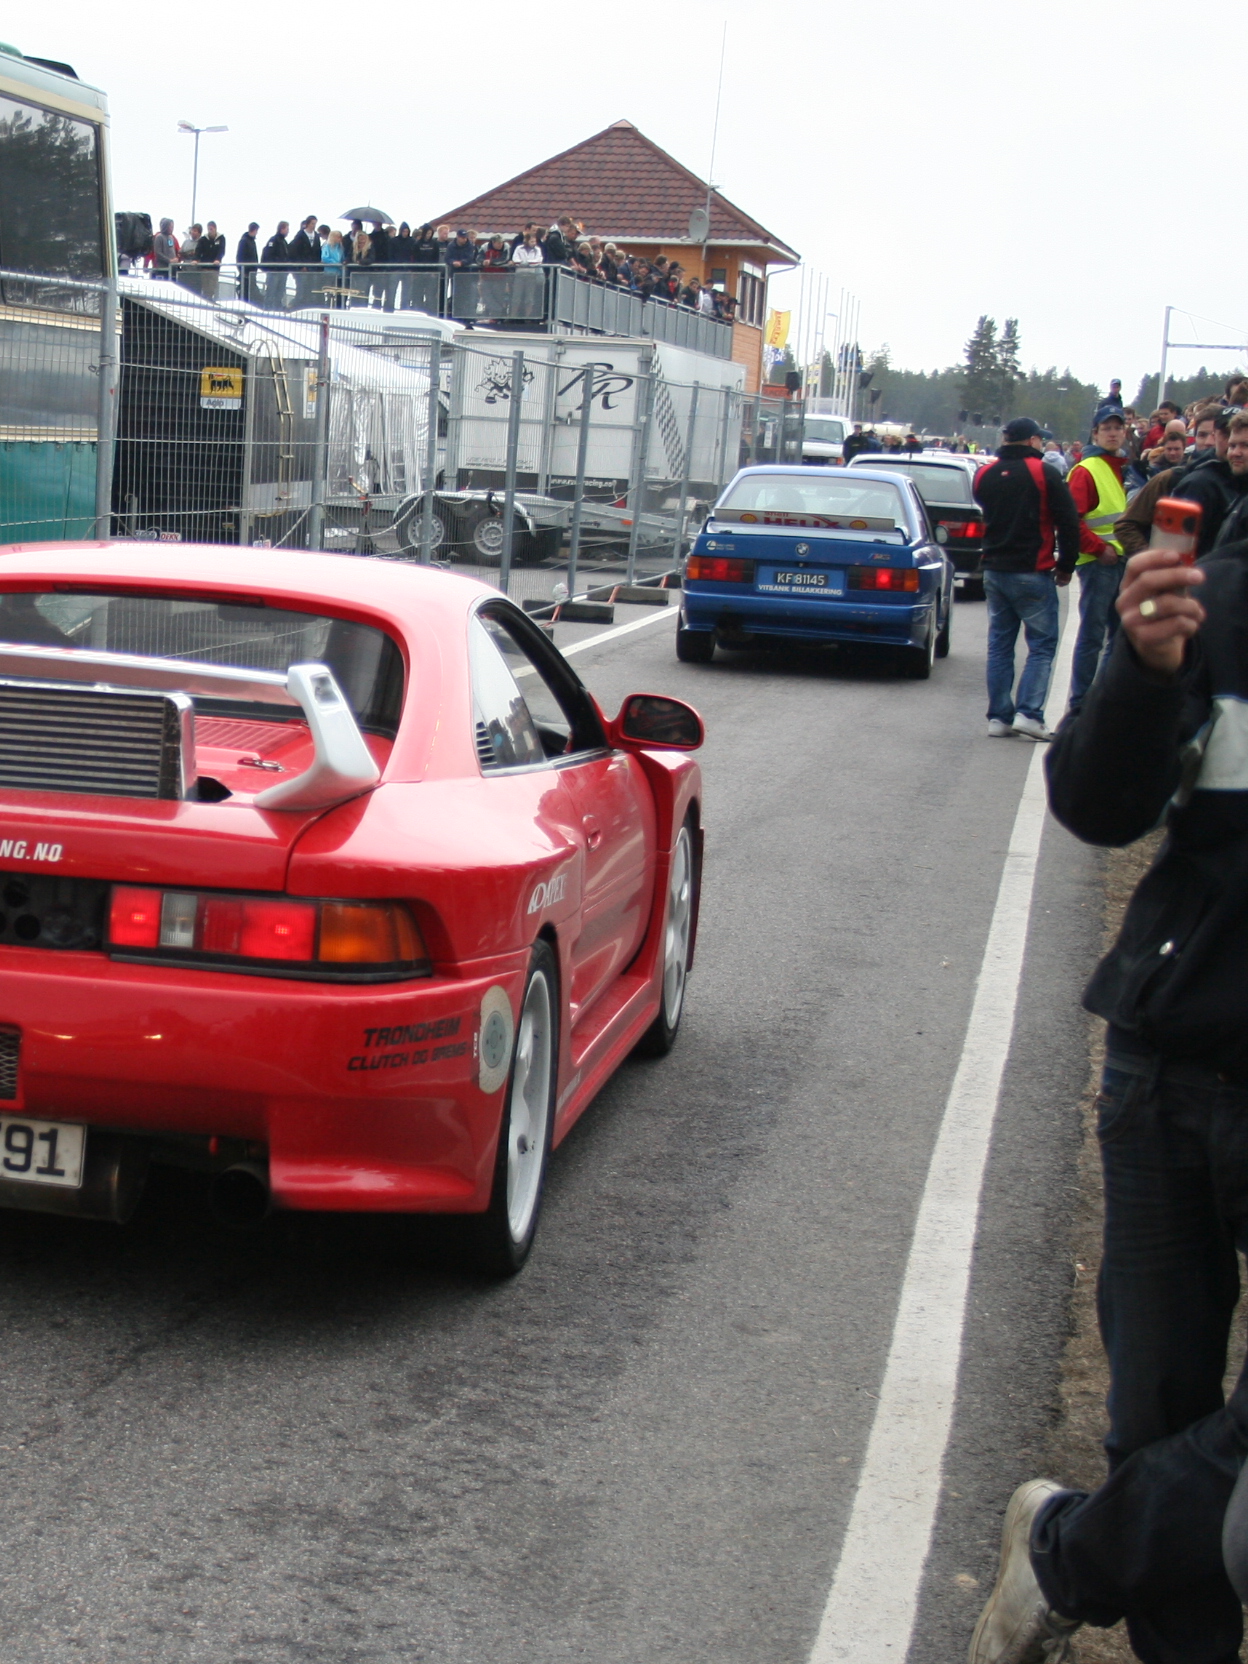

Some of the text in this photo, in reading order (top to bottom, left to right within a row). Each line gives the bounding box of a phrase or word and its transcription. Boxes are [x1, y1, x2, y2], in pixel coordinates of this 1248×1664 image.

[206, 398, 224, 408] Agip
[777, 573, 825, 586] KF 81145
[758, 584, 843, 596] VITBANK BILLAKKERING
[363, 1017, 462, 1048] TRONDHEIM
[347, 1052, 409, 1071] CLUTCH
